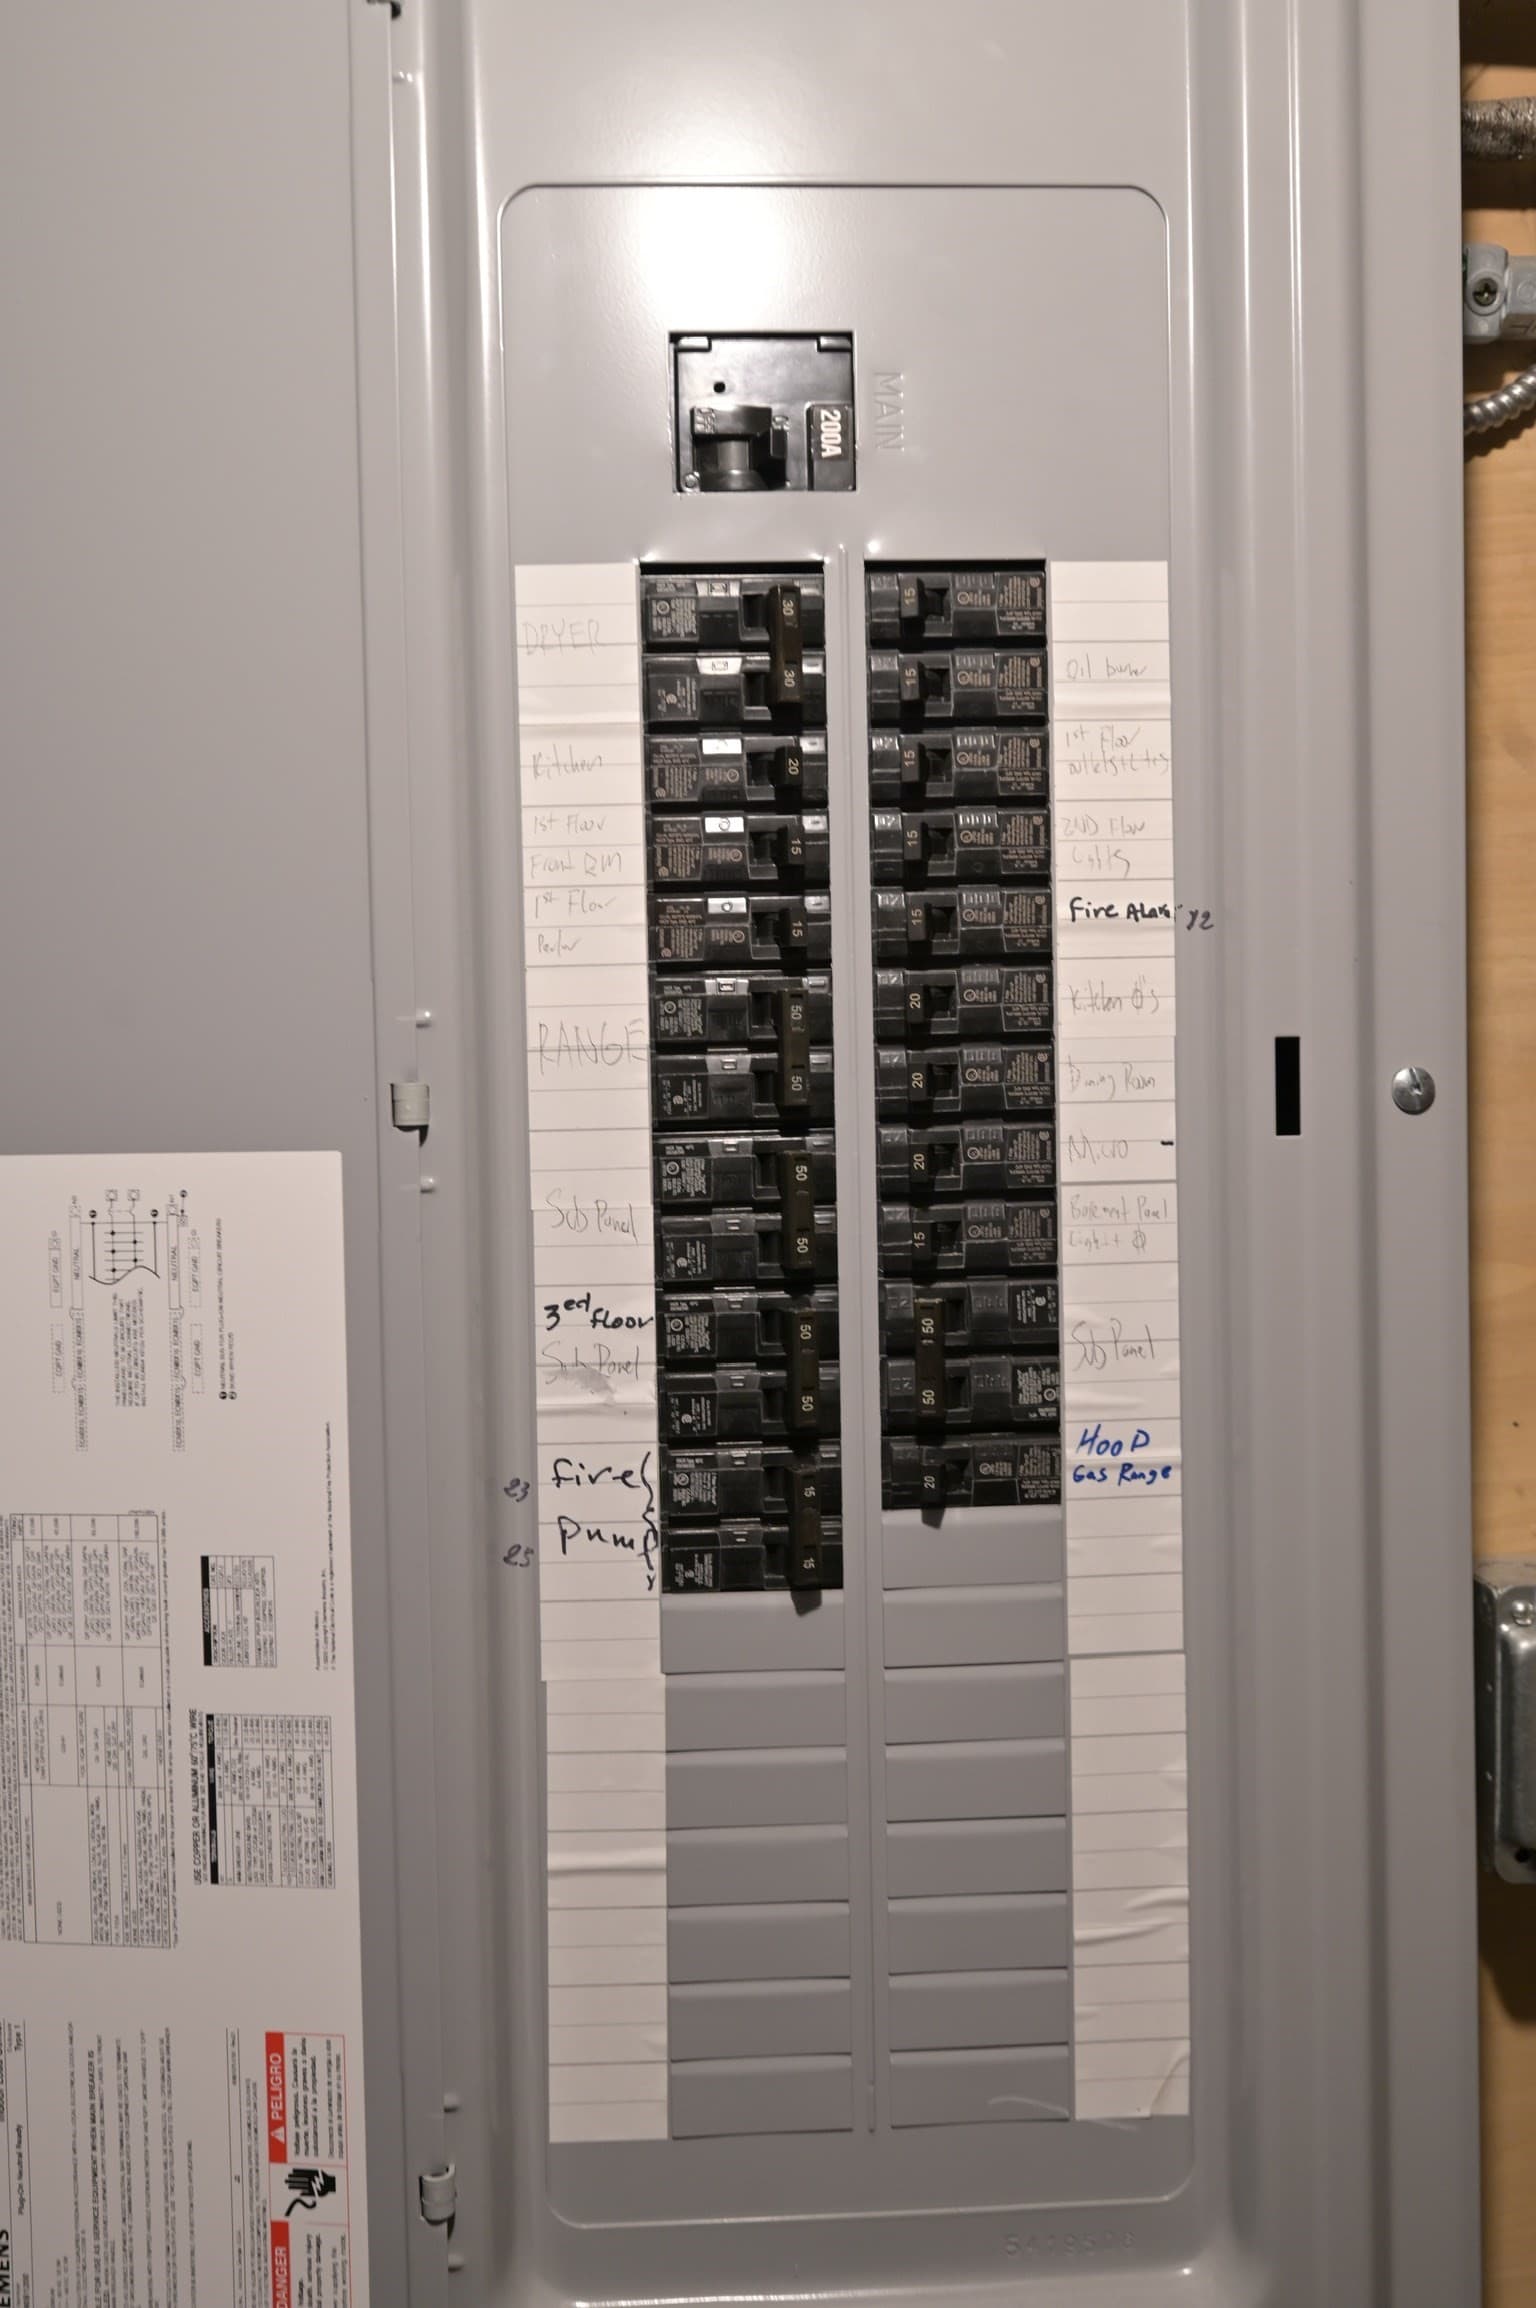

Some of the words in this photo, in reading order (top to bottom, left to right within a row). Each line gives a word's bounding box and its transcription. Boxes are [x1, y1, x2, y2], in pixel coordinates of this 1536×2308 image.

[873, 371, 905, 452] MAIN
[820, 408, 842, 459] 200A
[904, 587, 916, 606] 15
[782, 599, 794, 617] 30
[522, 618, 600, 655] DRYER
[783, 670, 796, 688] 30
[905, 667, 917, 687] 15
[787, 758, 800, 776] 20
[903, 750, 915, 768] 15
[791, 839, 802, 856] 15
[906, 830, 918, 848] 15
[911, 908, 922, 926] 15
[792, 921, 804, 937] 15
[909, 992, 921, 1010] 20
[791, 1005, 803, 1020] 50
[538, 1017, 648, 1076] RANGE
[791, 1075, 803, 1092] 50
[911, 1072, 923, 1089] 20
[913, 1153, 926, 1170] 20
[795, 1165, 808, 1182] 50
[796, 1237, 809, 1254] 50
[914, 1231, 926, 1249] 15
[800, 1324, 812, 1341] 50
[921, 1317, 935, 1335] 50
[801, 1396, 814, 1413] 50
[922, 1389, 936, 1406] 50
[924, 1476, 936, 1490] 20
[1072, 1464, 1108, 1483] Gas
[1118, 1463, 1173, 1486] Range
[803, 1485, 816, 1498] 15
[803, 1556, 816, 1570] 15
[269, 2052, 283, 2121] PELIGRO
[274, 2246, 288, 2308] DANGER
